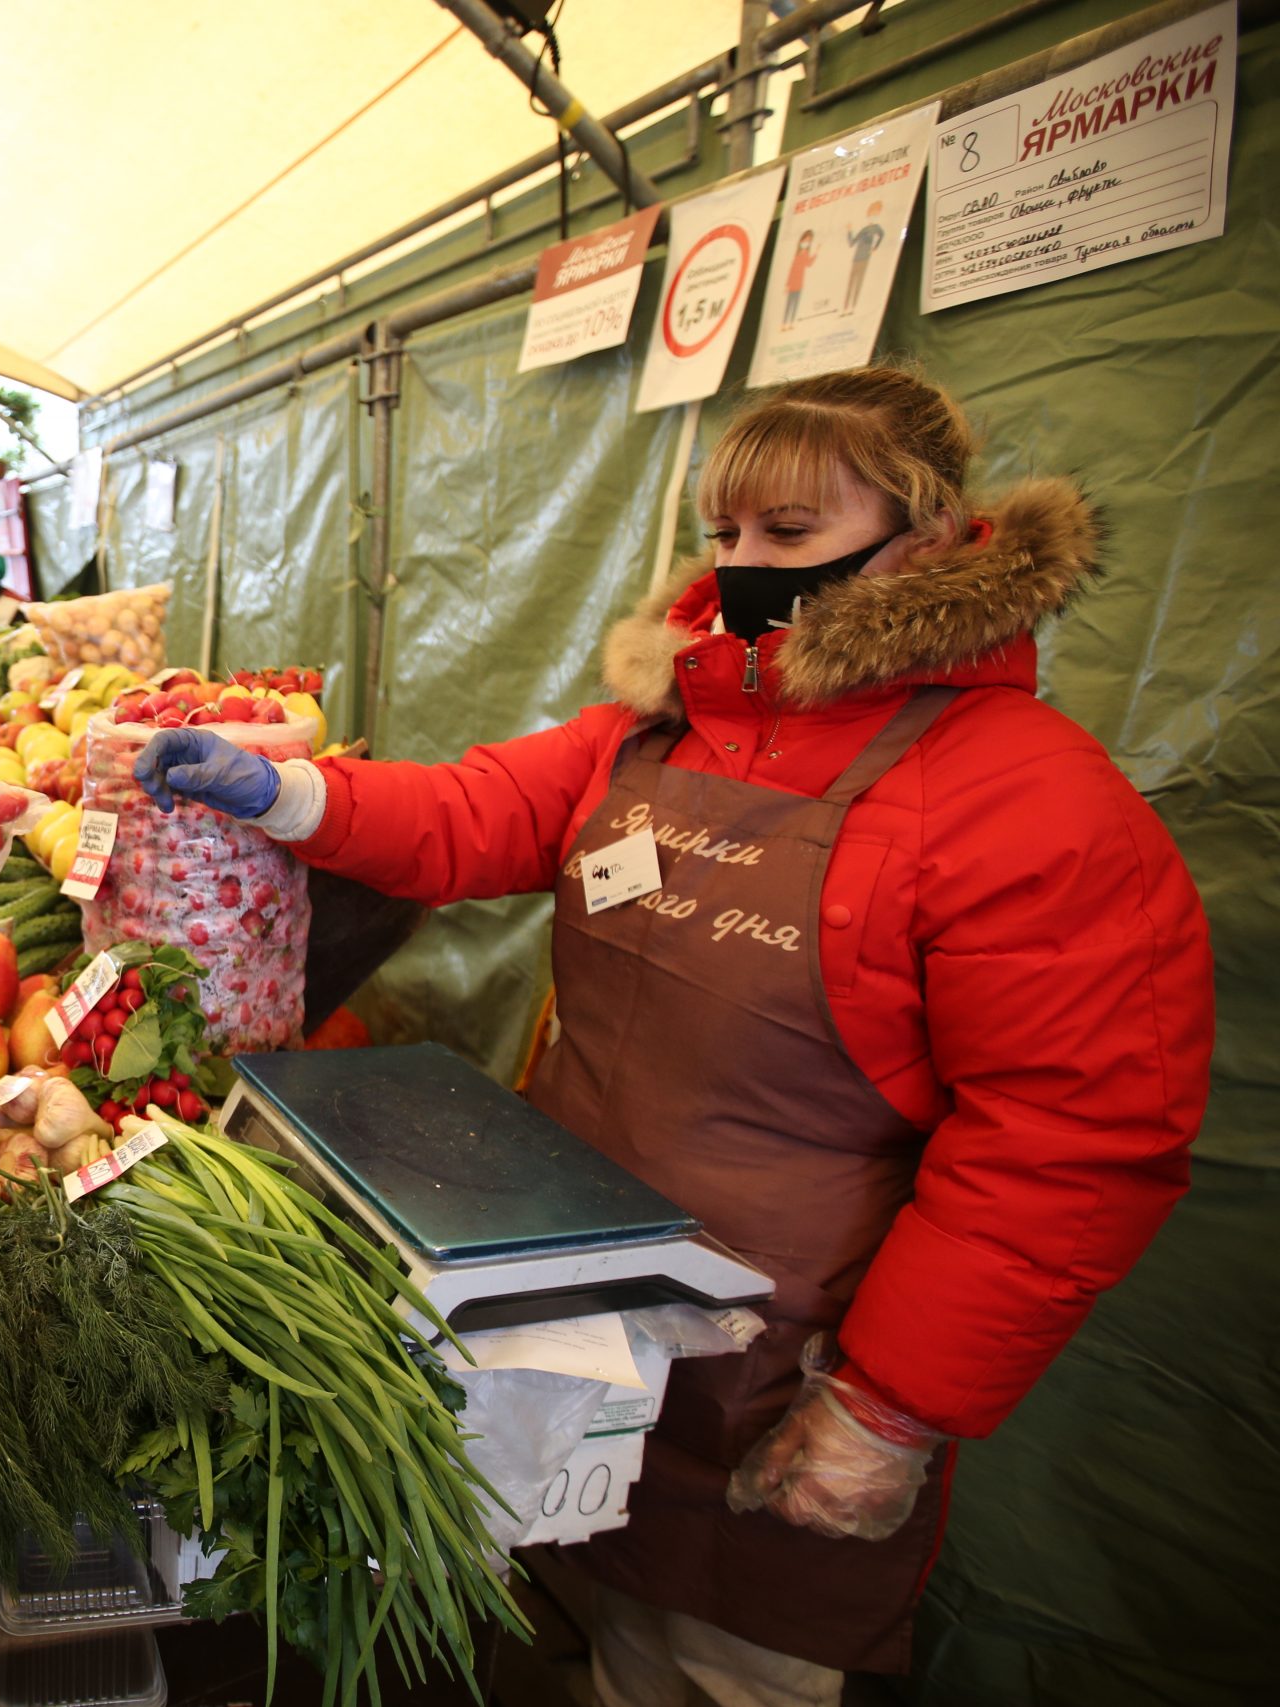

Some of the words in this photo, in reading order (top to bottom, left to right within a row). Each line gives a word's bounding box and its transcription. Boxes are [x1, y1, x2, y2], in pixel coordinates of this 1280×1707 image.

[1032, 34, 1224, 127] Московские
[1019, 59, 1218, 162] ЯРМАРКИ
[959, 131, 980, 173] 8
[1014, 183, 1044, 199] Район
[553, 244, 630, 289] ЯРМАРКИ
[958, 262, 1032, 290] происхождения
[1033, 252, 1068, 270] товара
[1073, 235, 1131, 264] Тульская
[582, 305, 624, 339] 10%
[676, 298, 708, 332] 1,5
[711, 907, 801, 952] дня
